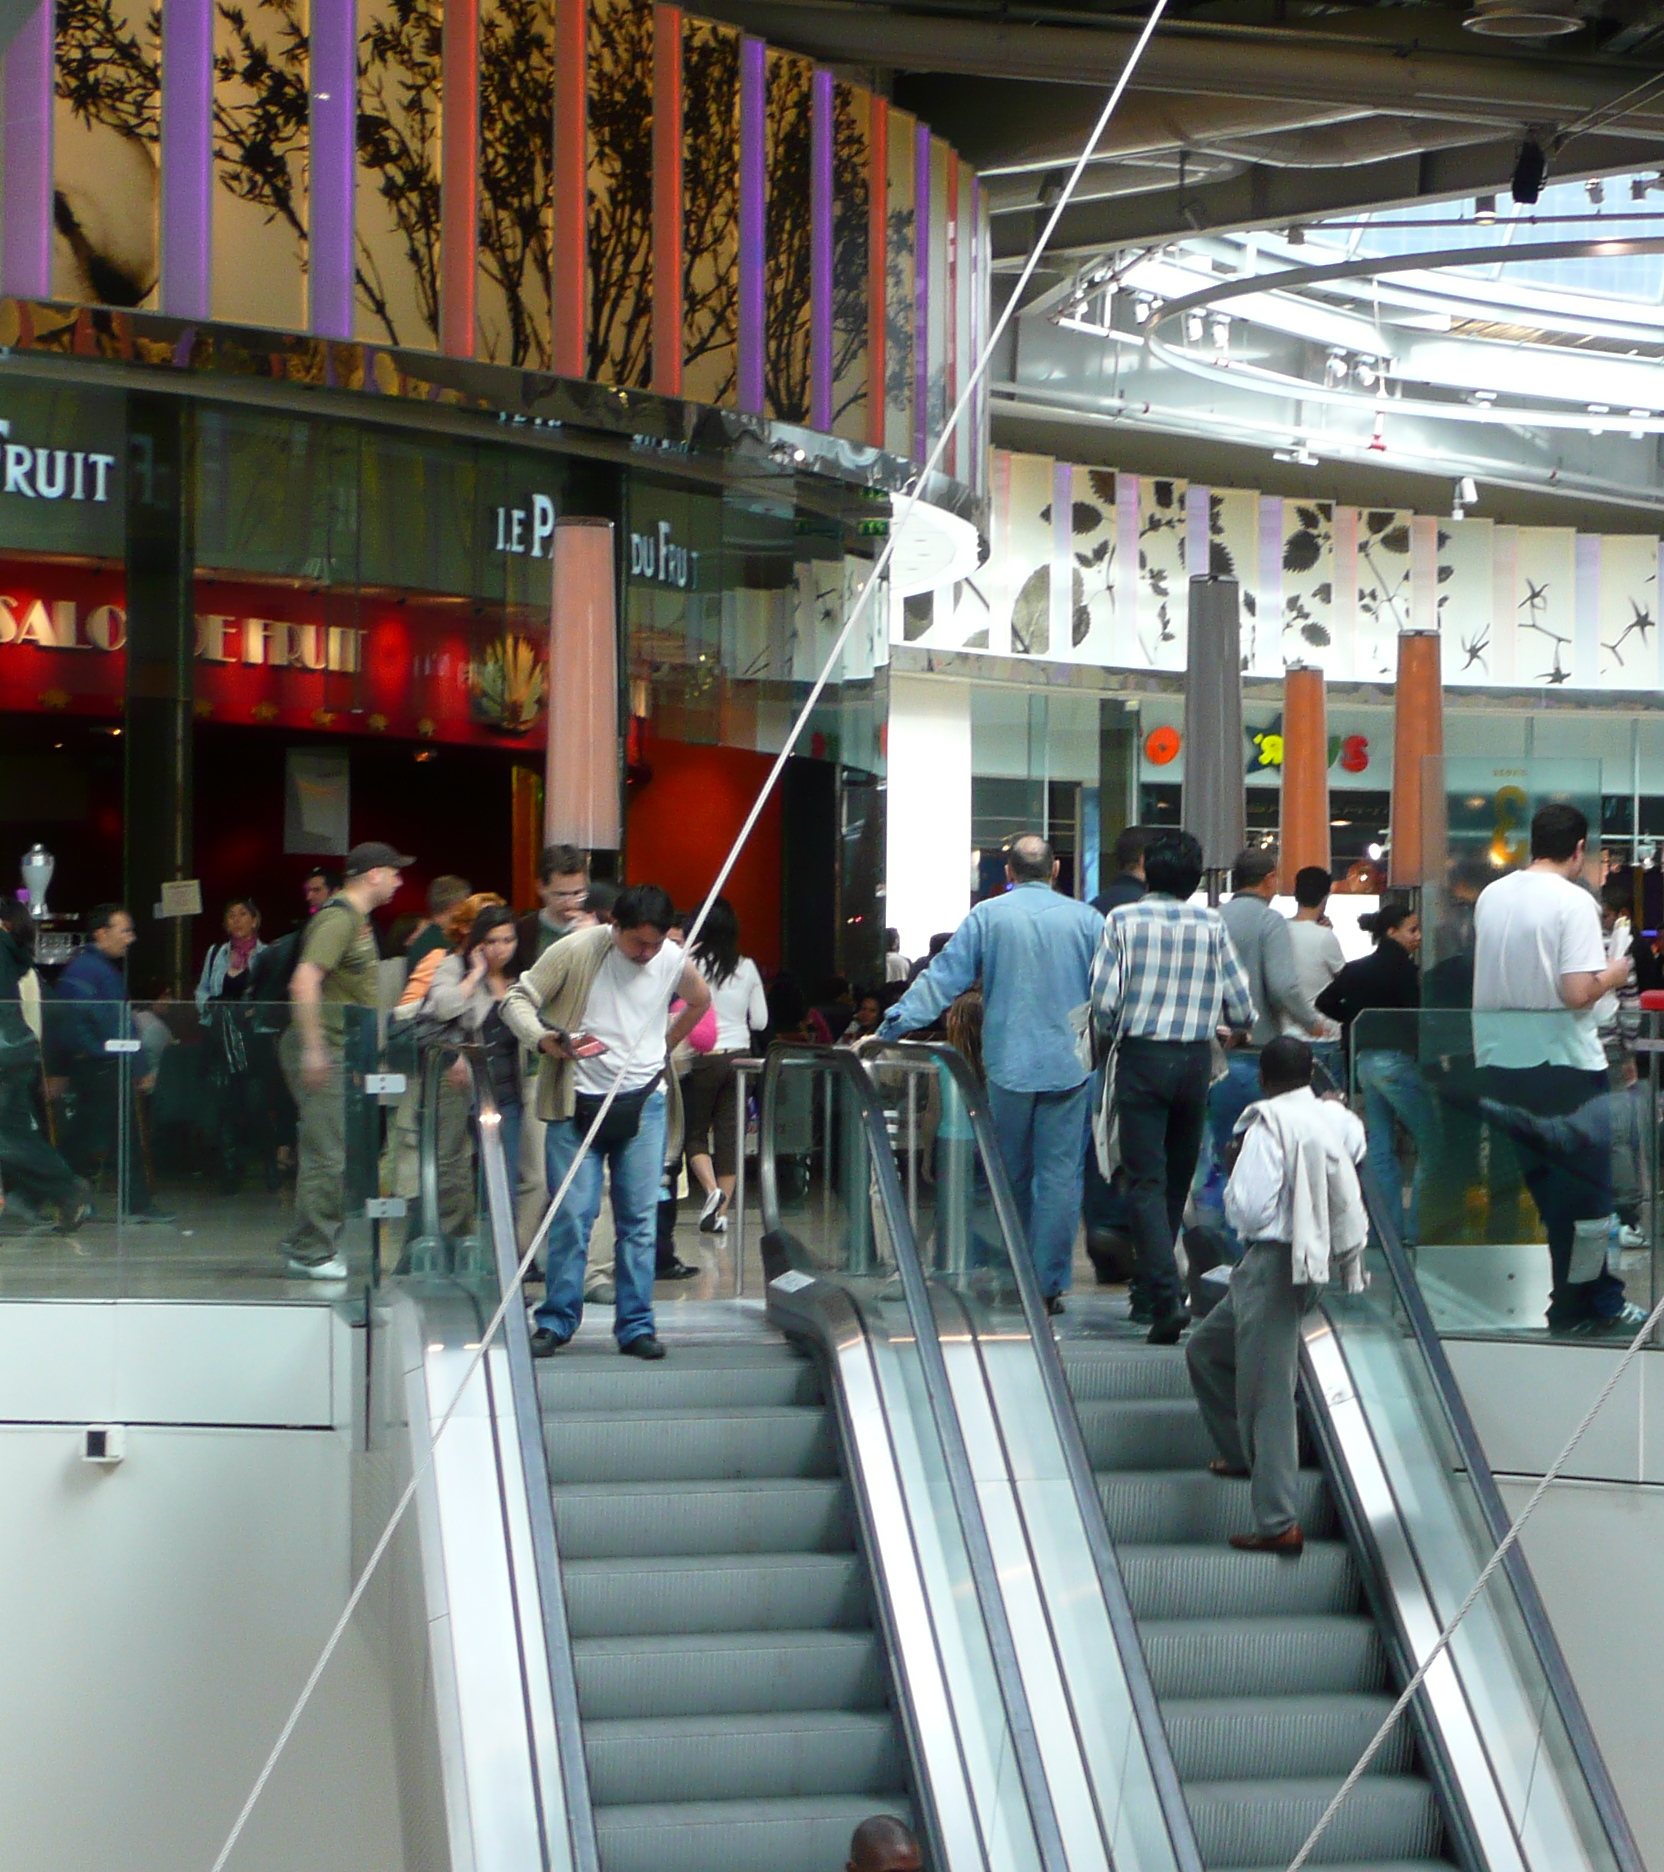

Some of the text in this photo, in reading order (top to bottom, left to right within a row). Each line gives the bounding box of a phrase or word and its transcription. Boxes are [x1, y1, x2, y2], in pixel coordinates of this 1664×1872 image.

[0, 418, 116, 502] RUIT
[495, 507, 526, 554] LE
[630, 532, 655, 578] DU
[0, 595, 127, 652] SALO
[242, 617, 368, 674] FRUIT
